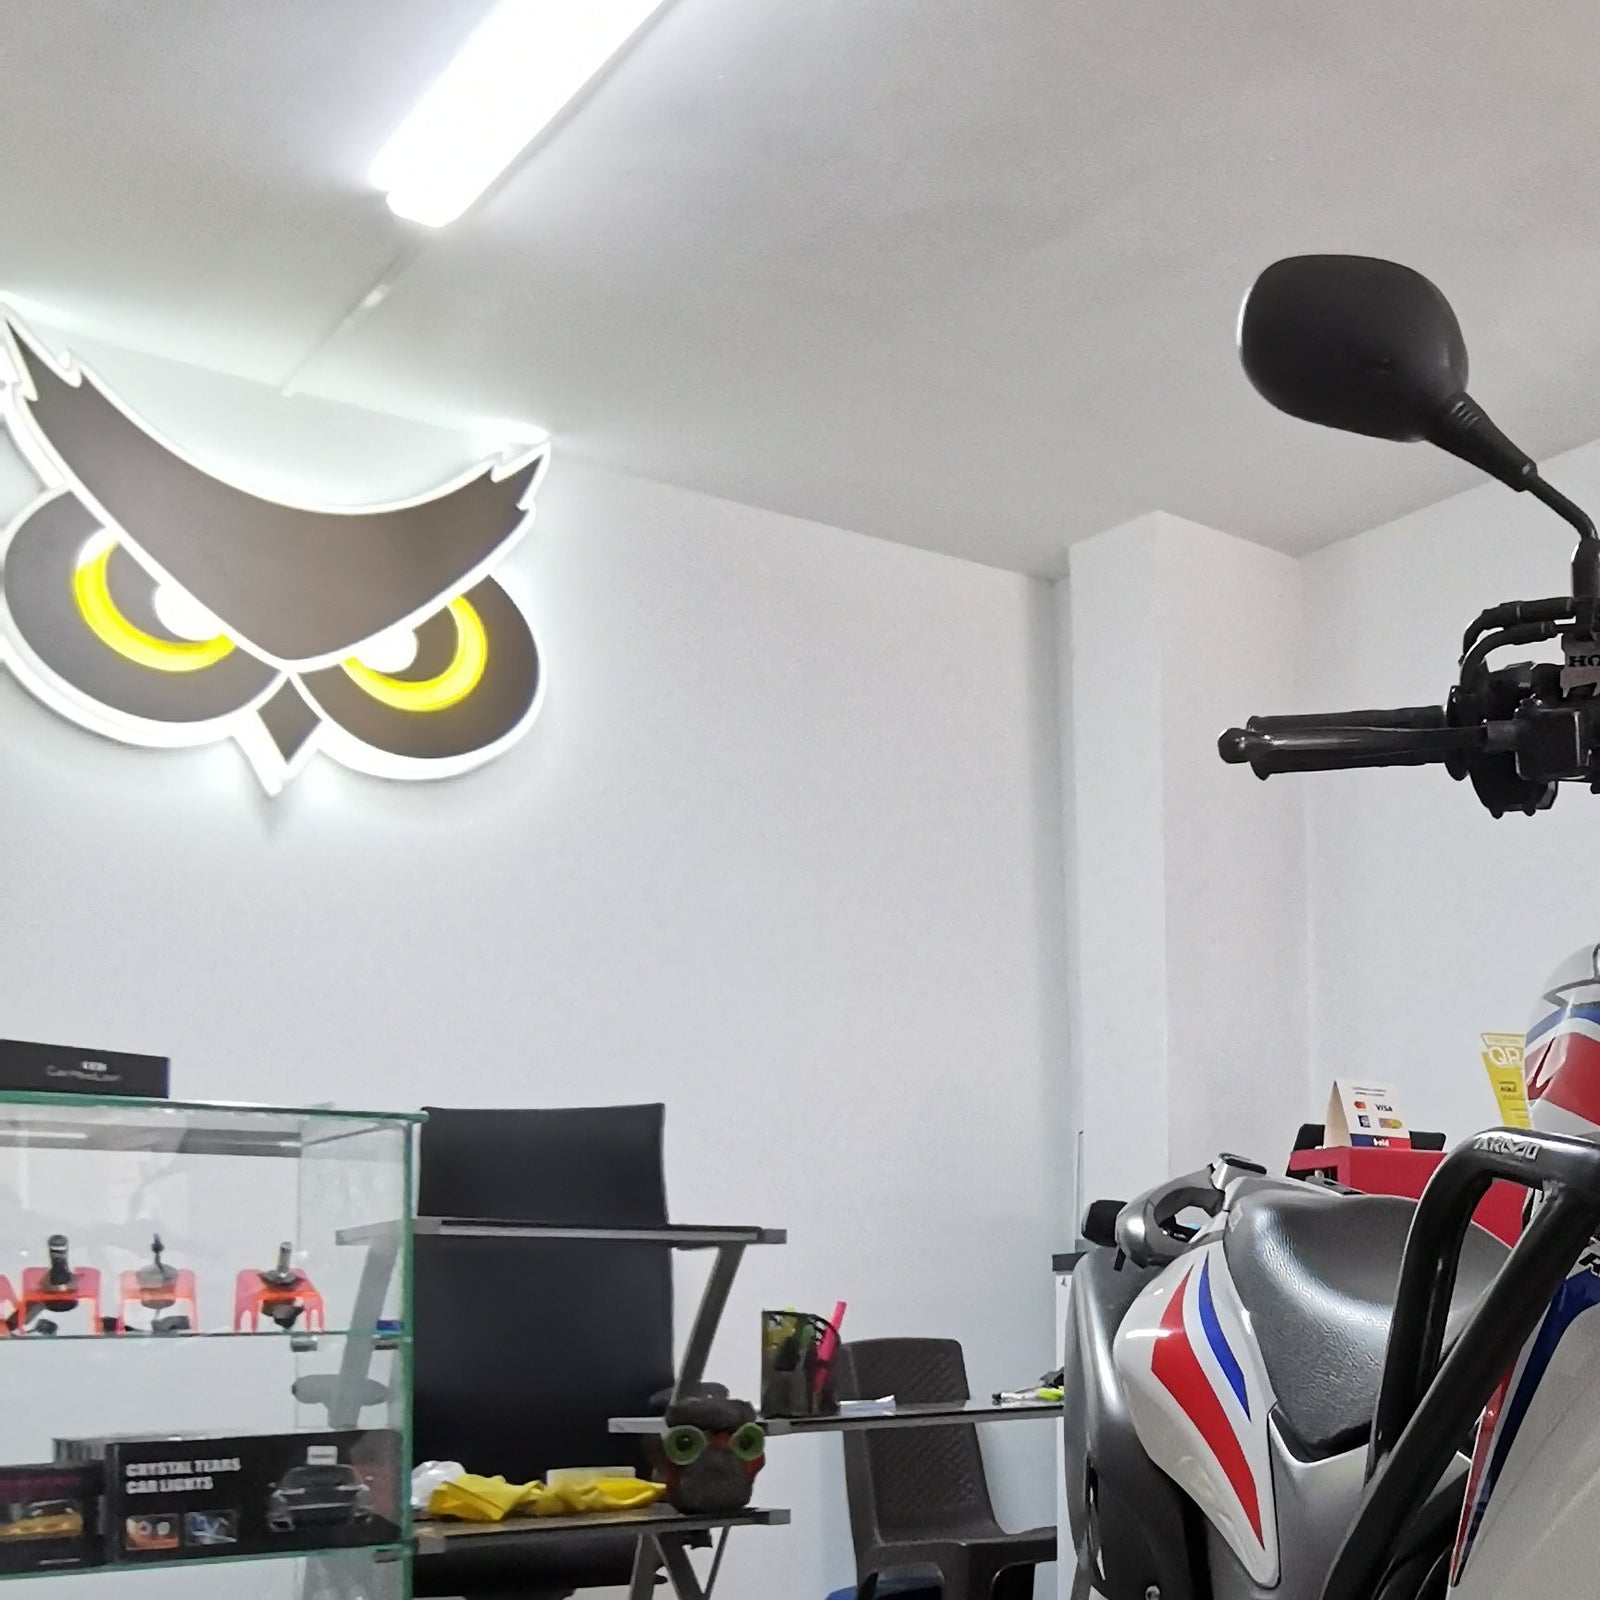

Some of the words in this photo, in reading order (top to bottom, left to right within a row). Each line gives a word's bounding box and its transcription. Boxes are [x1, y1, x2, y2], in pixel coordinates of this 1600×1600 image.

[1374, 1103, 1394, 1112] VISA
[126, 1479, 158, 1495] CAR
[159, 1475, 214, 1492] LIGHTS
